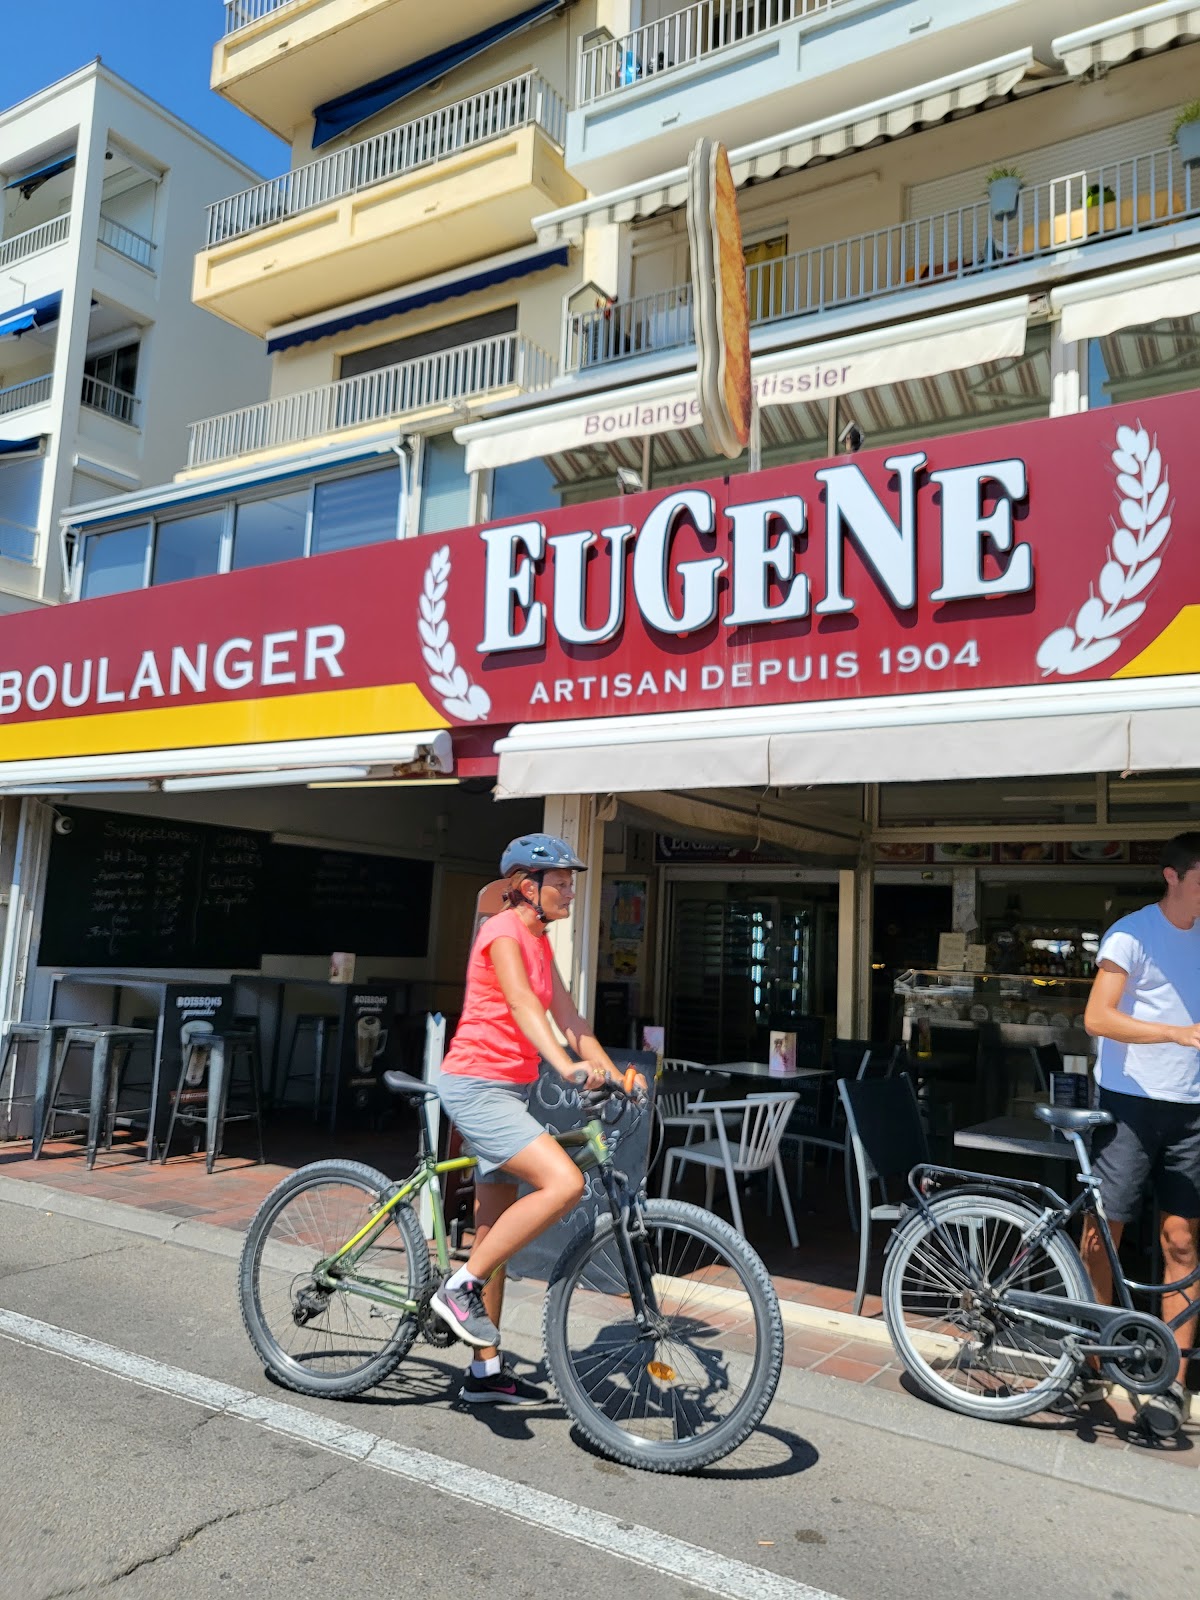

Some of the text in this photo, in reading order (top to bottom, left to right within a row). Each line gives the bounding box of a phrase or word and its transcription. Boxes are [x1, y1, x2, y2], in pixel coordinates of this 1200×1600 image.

[583, 363, 852, 436] Boulange tissier
[475, 452, 1031, 654] EUGENE
[0, 623, 346, 715] BOULANGER
[529, 639, 981, 705] ARTISAN DEPUIS 1904
[176, 996, 223, 1008] BOISSONS
[351, 995, 389, 1006] BOISSONS
